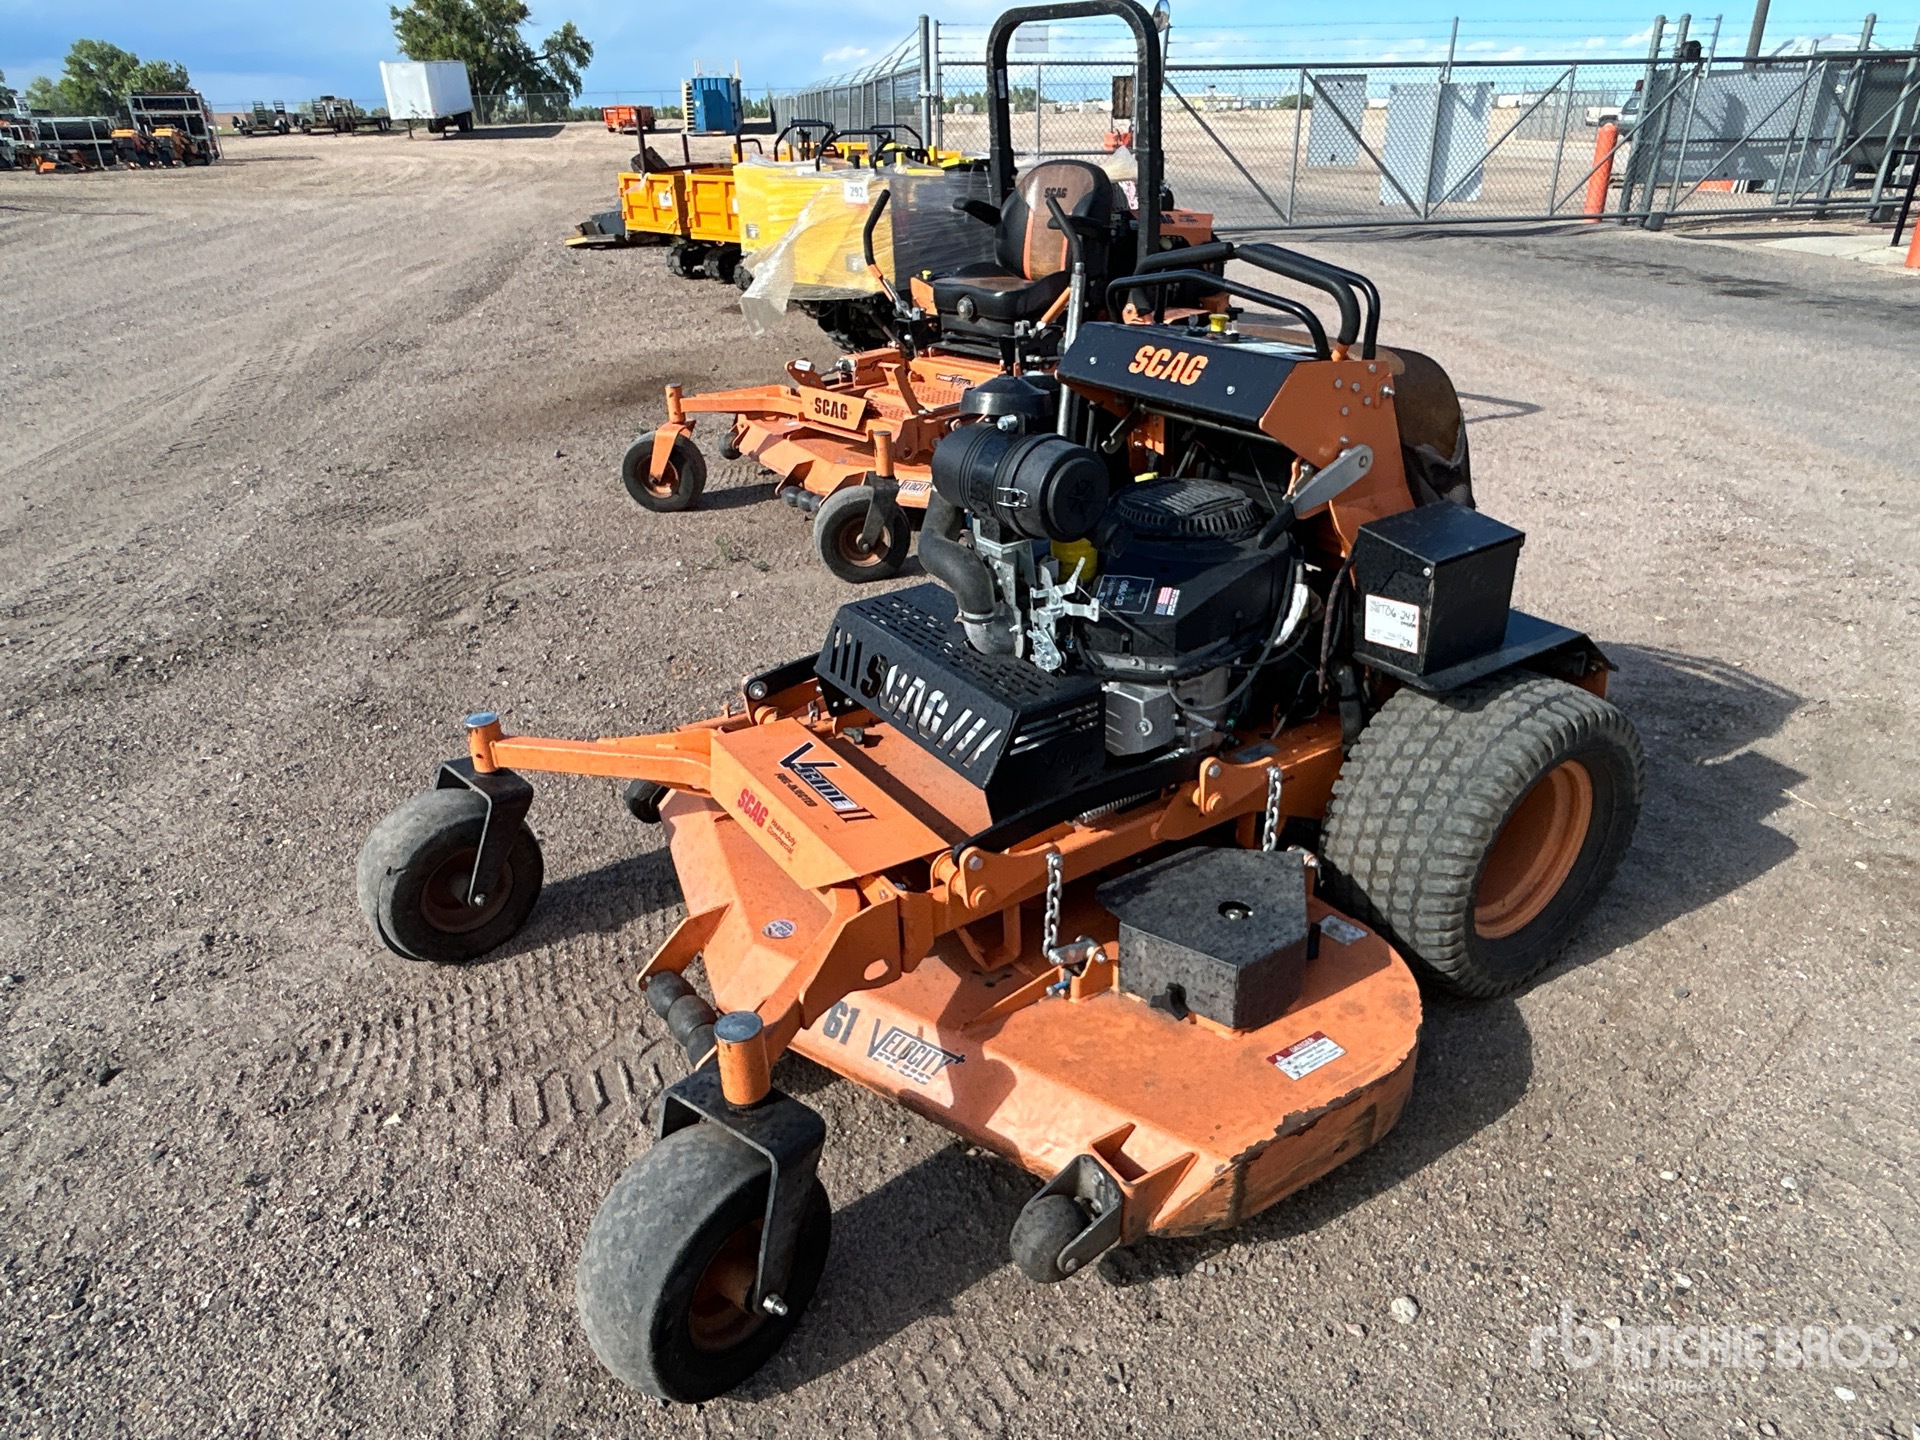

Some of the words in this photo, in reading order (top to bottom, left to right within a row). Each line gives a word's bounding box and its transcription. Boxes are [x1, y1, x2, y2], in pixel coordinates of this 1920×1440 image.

[849, 186, 864, 198] 292
[1044, 187, 1068, 199] SCAG
[1128, 345, 1209, 386] SCAG
[814, 397, 848, 420] SCAG
[859, 652, 949, 740] SCAG
[737, 788, 769, 828] SCAG
[767, 826, 795, 854] Commercial
[771, 819, 796, 847] Heavy-Duty
[823, 1000, 861, 1046] 61
